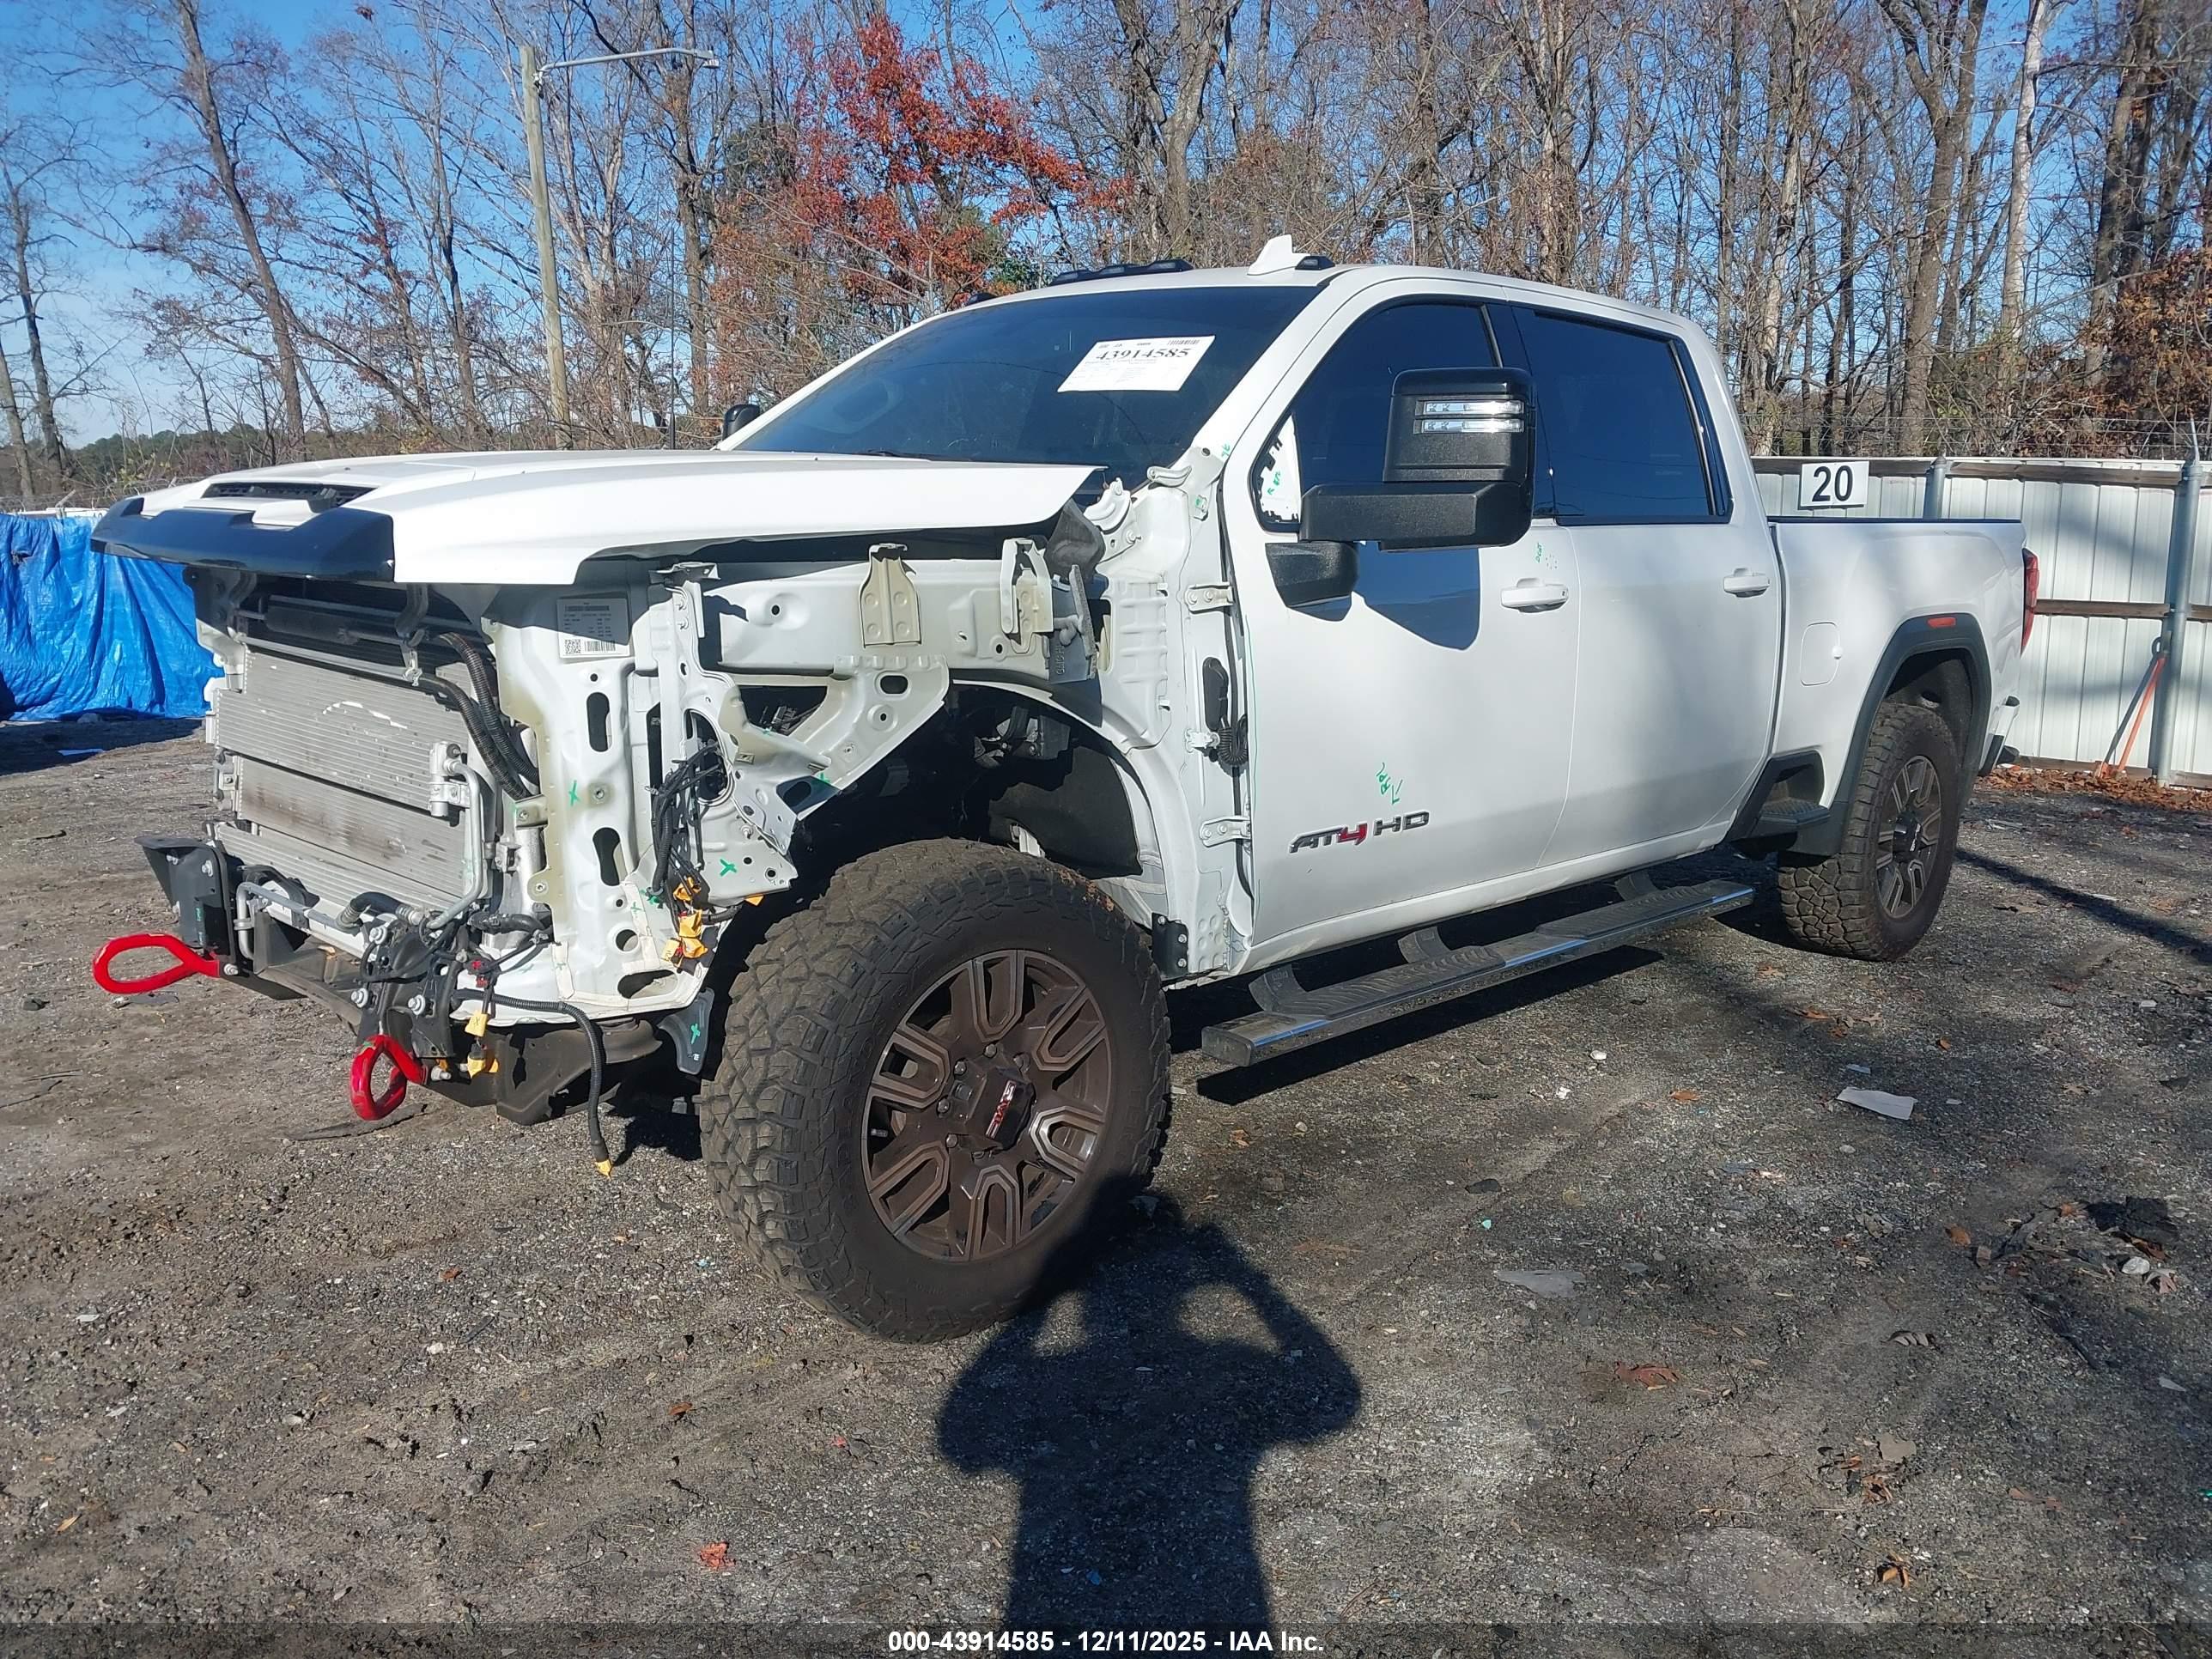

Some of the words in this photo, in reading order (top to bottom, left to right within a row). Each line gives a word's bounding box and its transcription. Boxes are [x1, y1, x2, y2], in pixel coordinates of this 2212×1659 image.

[1096, 347, 1193, 361] 43914585
[1812, 465, 1853, 502] 20
[1289, 822, 1369, 854] AT4
[1372, 810, 1431, 836] HD
